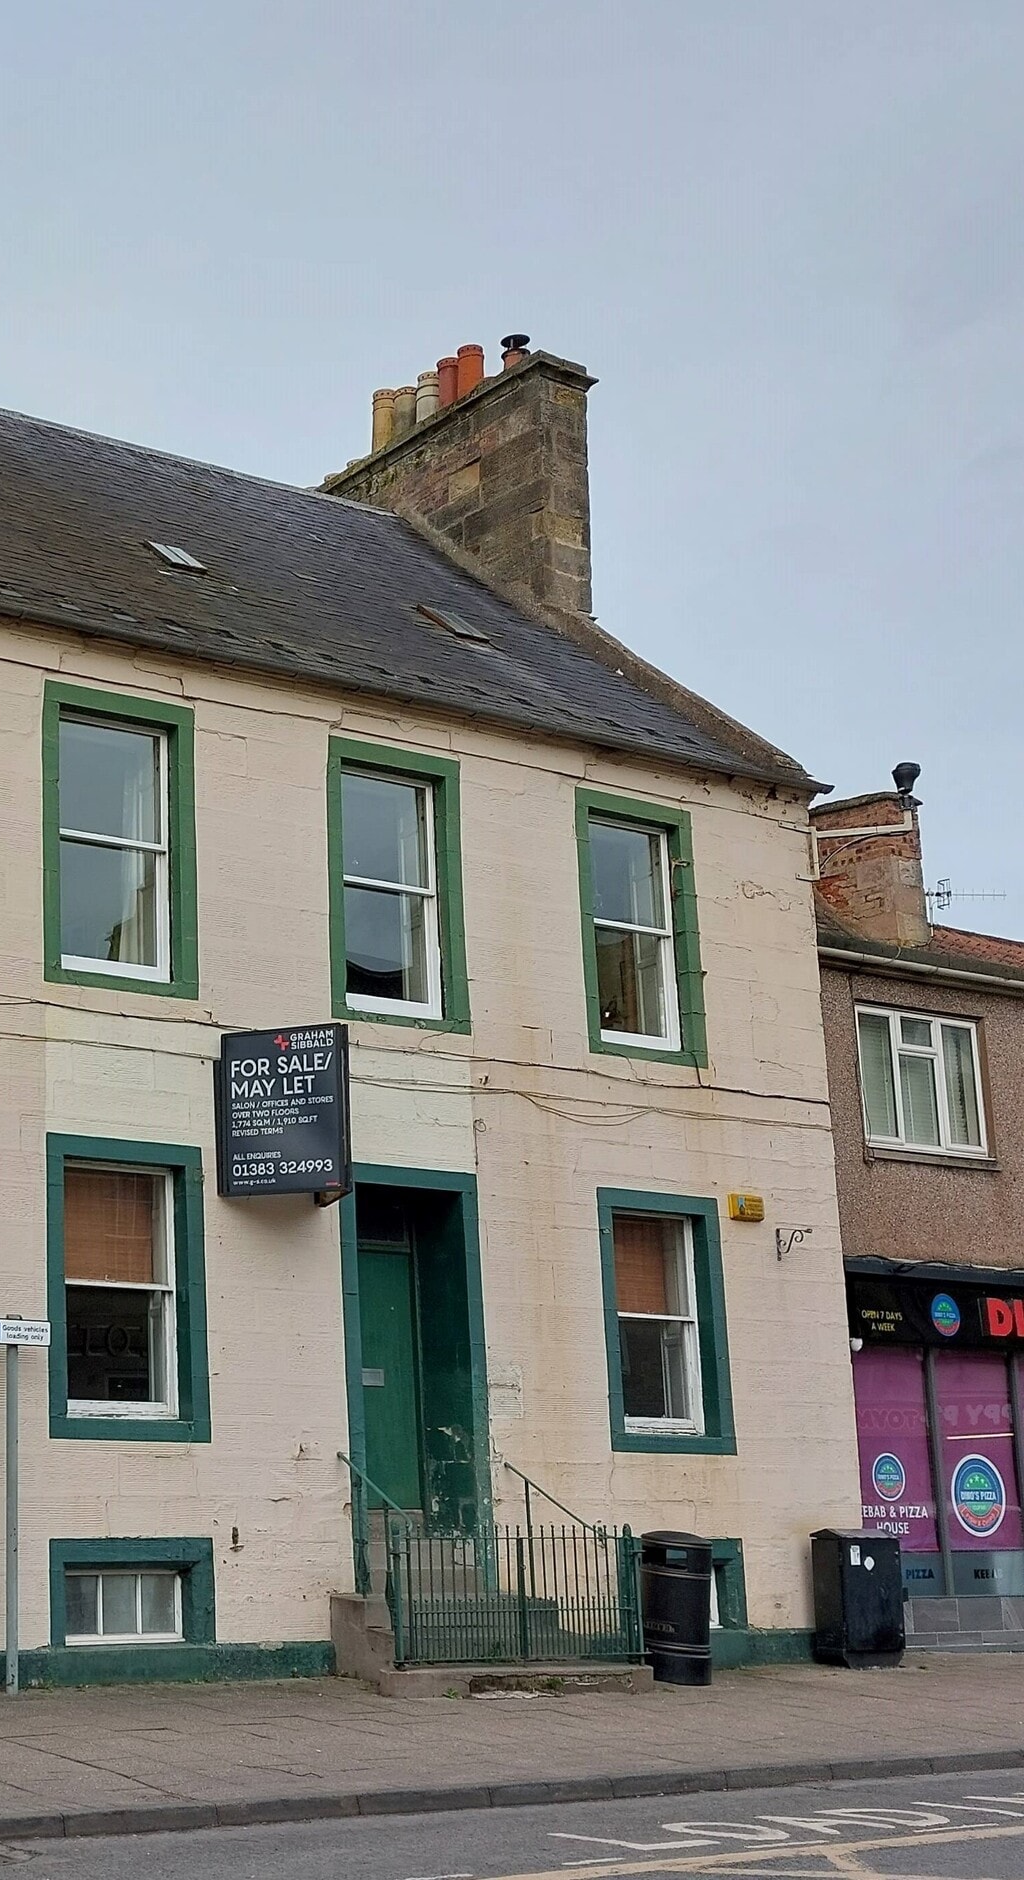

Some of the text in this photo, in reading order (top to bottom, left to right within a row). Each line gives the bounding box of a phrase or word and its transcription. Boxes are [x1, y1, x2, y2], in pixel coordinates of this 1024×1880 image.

[290, 1030, 334, 1041] GRAHAM
[291, 1038, 334, 1050] SIBBALD
[231, 1052, 332, 1078] FOR SALE/
[231, 1075, 315, 1099] MAY LET
[291, 1098, 306, 1106] AND
[308, 1096, 334, 1104] STORES
[232, 1111, 251, 1119] OVER
[271, 1108, 300, 1116] FLOORS
[232, 1127, 284, 1137] REVISED TERMS
[233, 1151, 282, 1161] ALL ENQUIRIES
[233, 1159, 333, 1176] 01383 324993
[861, 1310, 879, 1319] OPEN
[886, 1311, 903, 1321] DAYS
[2, 1324, 22, 1332] Goods
[877, 1323, 896, 1332] WEEK
[7, 1333, 29, 1341] loading
[861, 1505, 929, 1518] EBAB & PIZZA
[876, 1522, 910, 1534] HOUSE
[906, 1569, 935, 1579] PIZZA
